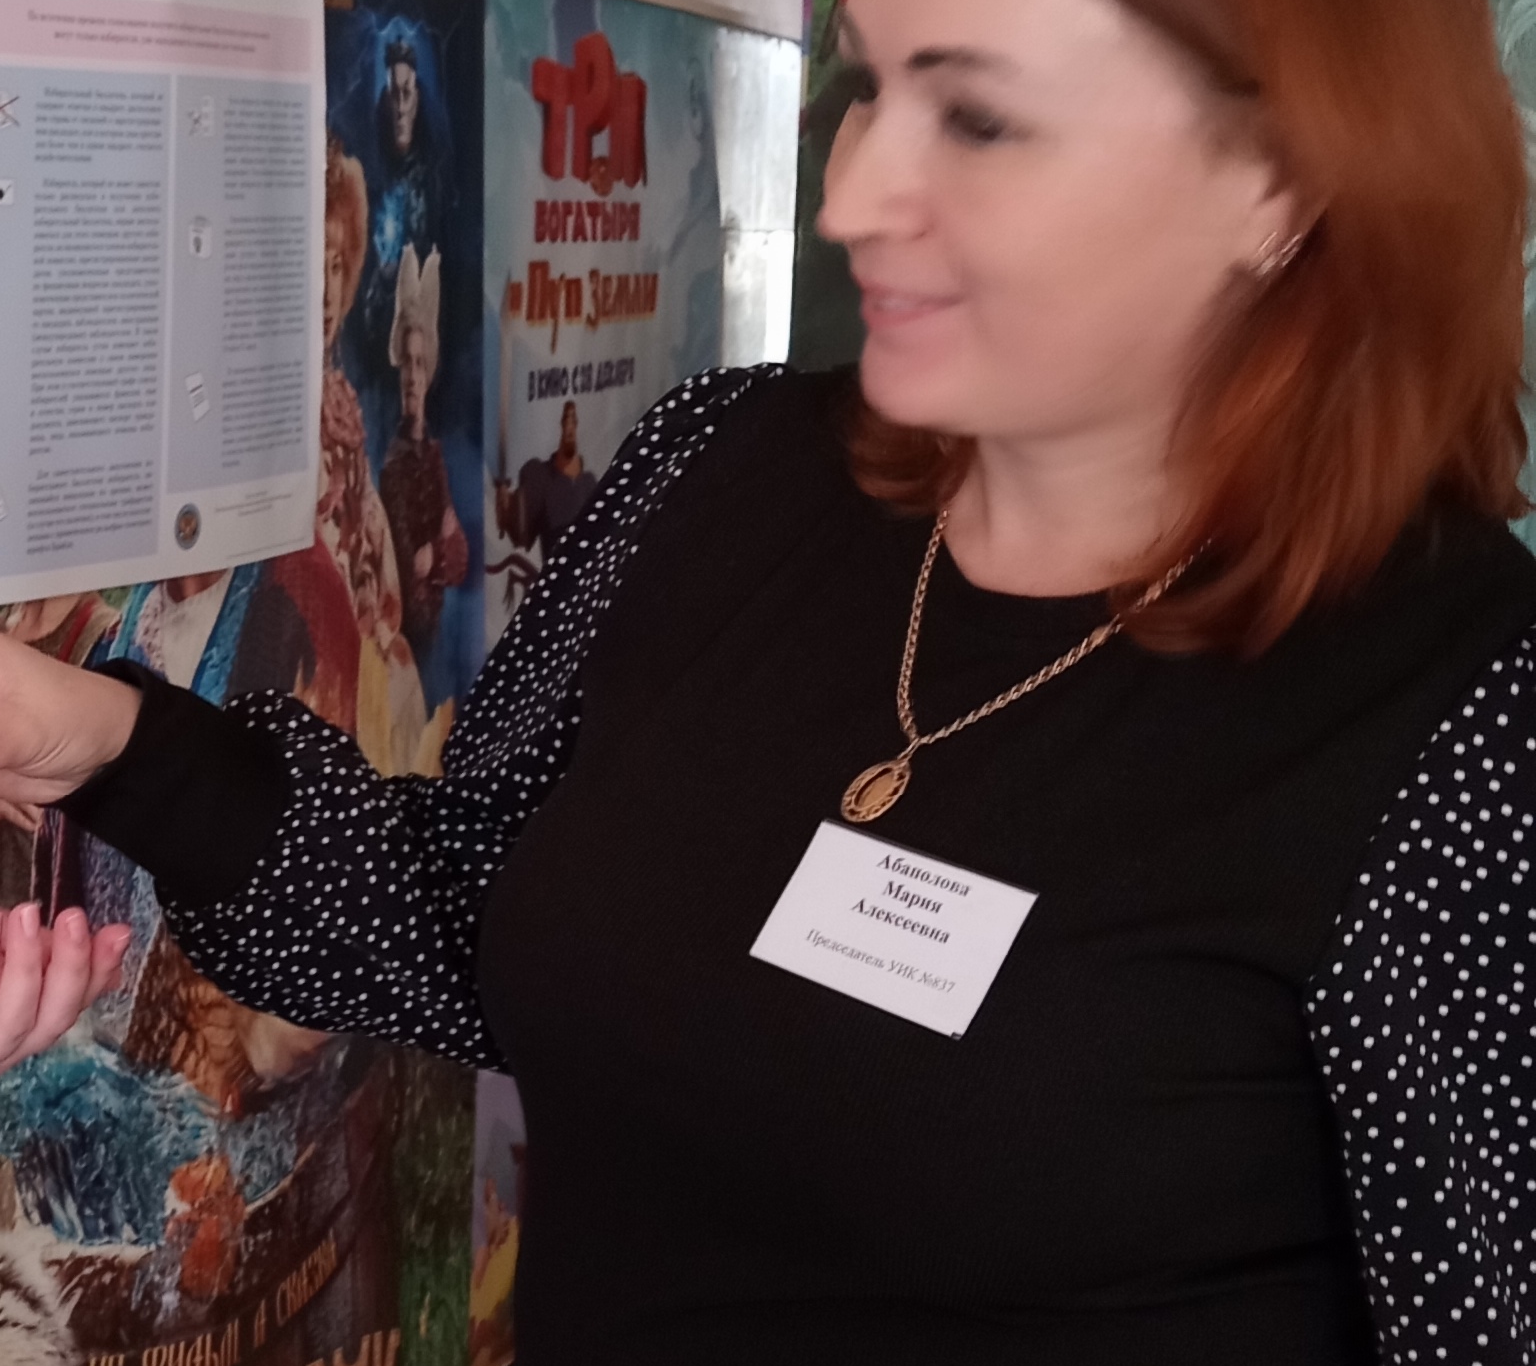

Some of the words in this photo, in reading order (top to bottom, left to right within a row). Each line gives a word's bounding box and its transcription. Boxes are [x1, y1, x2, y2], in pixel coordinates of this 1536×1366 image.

[534, 200, 641, 244] БОГАТЫРЯ
[881, 879, 944, 915] Мария
[849, 897, 952, 946] Алексеевна
[886, 960, 920, 982] УИК
